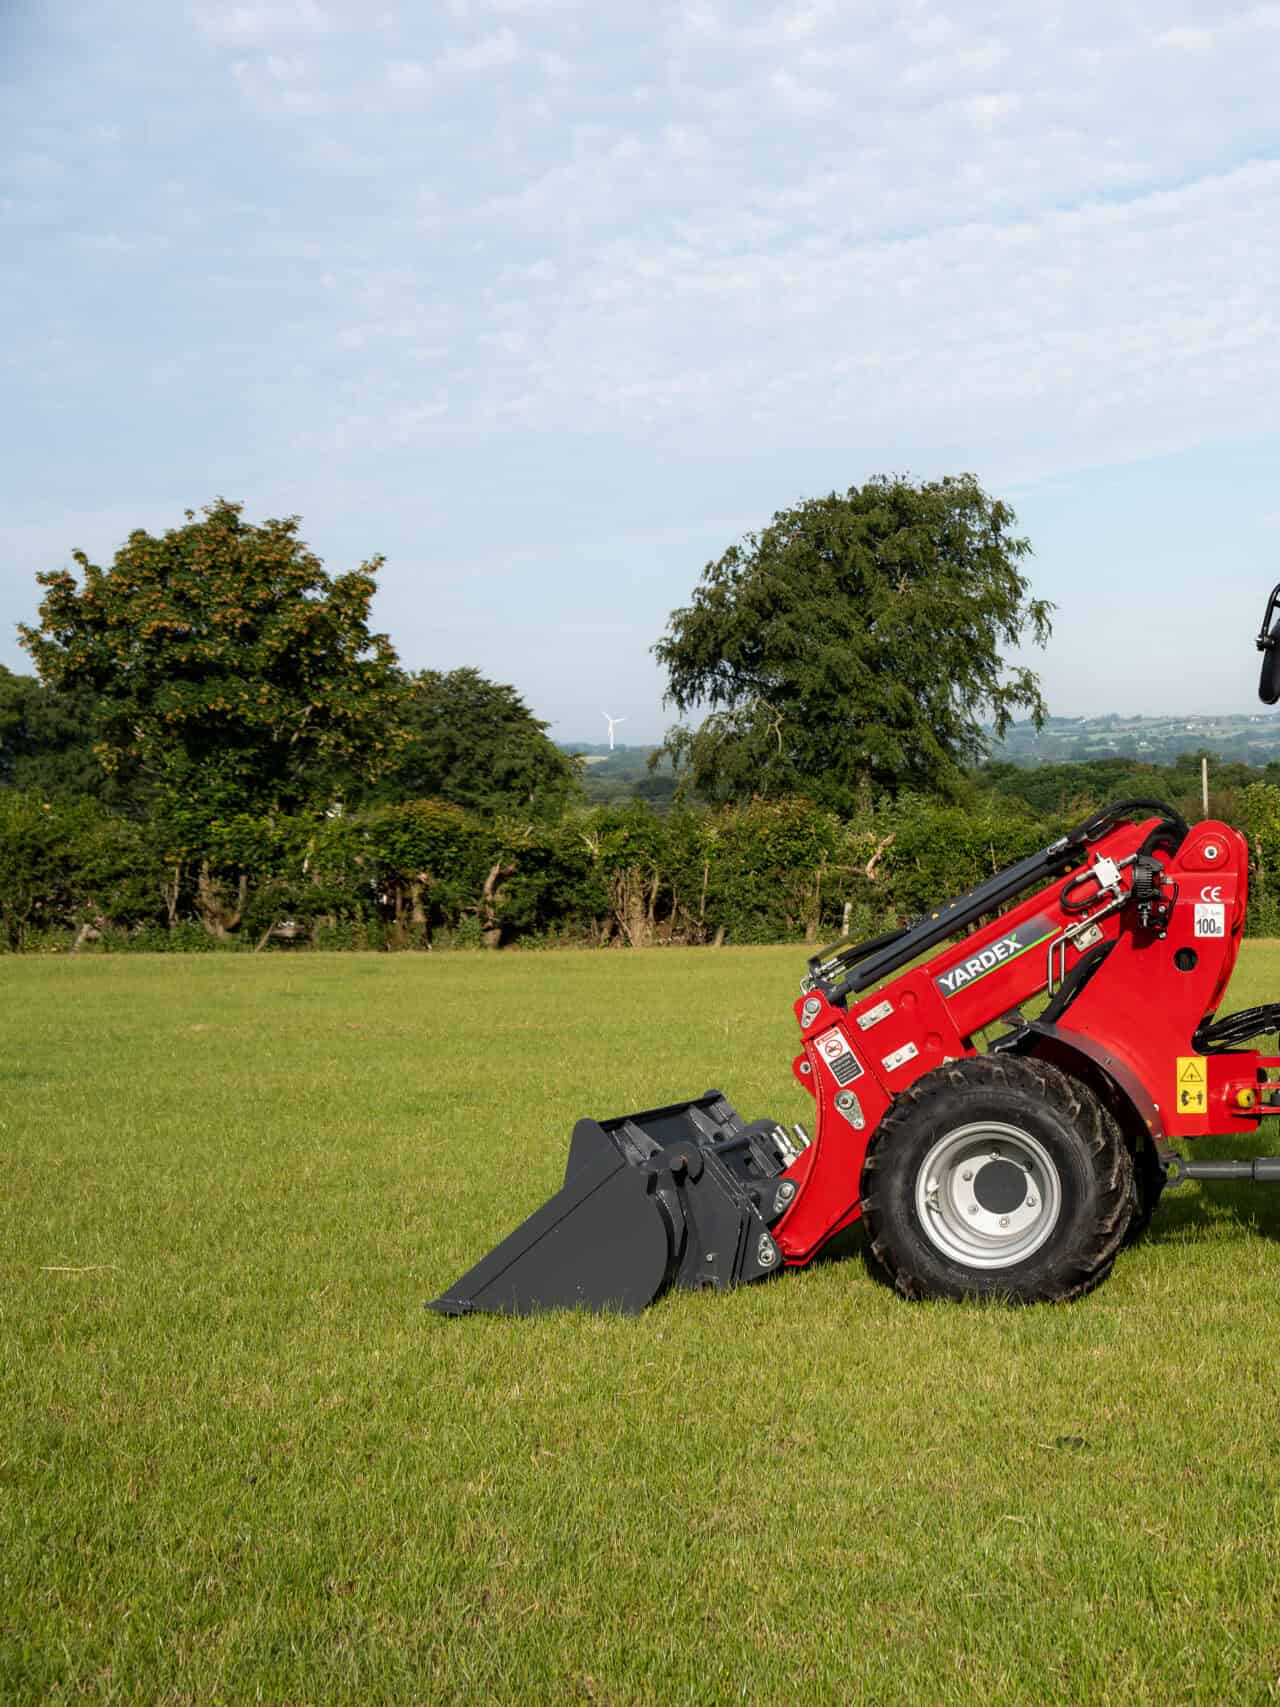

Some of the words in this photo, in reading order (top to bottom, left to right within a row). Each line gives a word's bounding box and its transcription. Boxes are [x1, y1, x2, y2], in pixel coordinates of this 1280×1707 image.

[1200, 886, 1222, 902] CE
[1196, 918, 1216, 934] 100
[939, 933, 1022, 990] YARDEX
